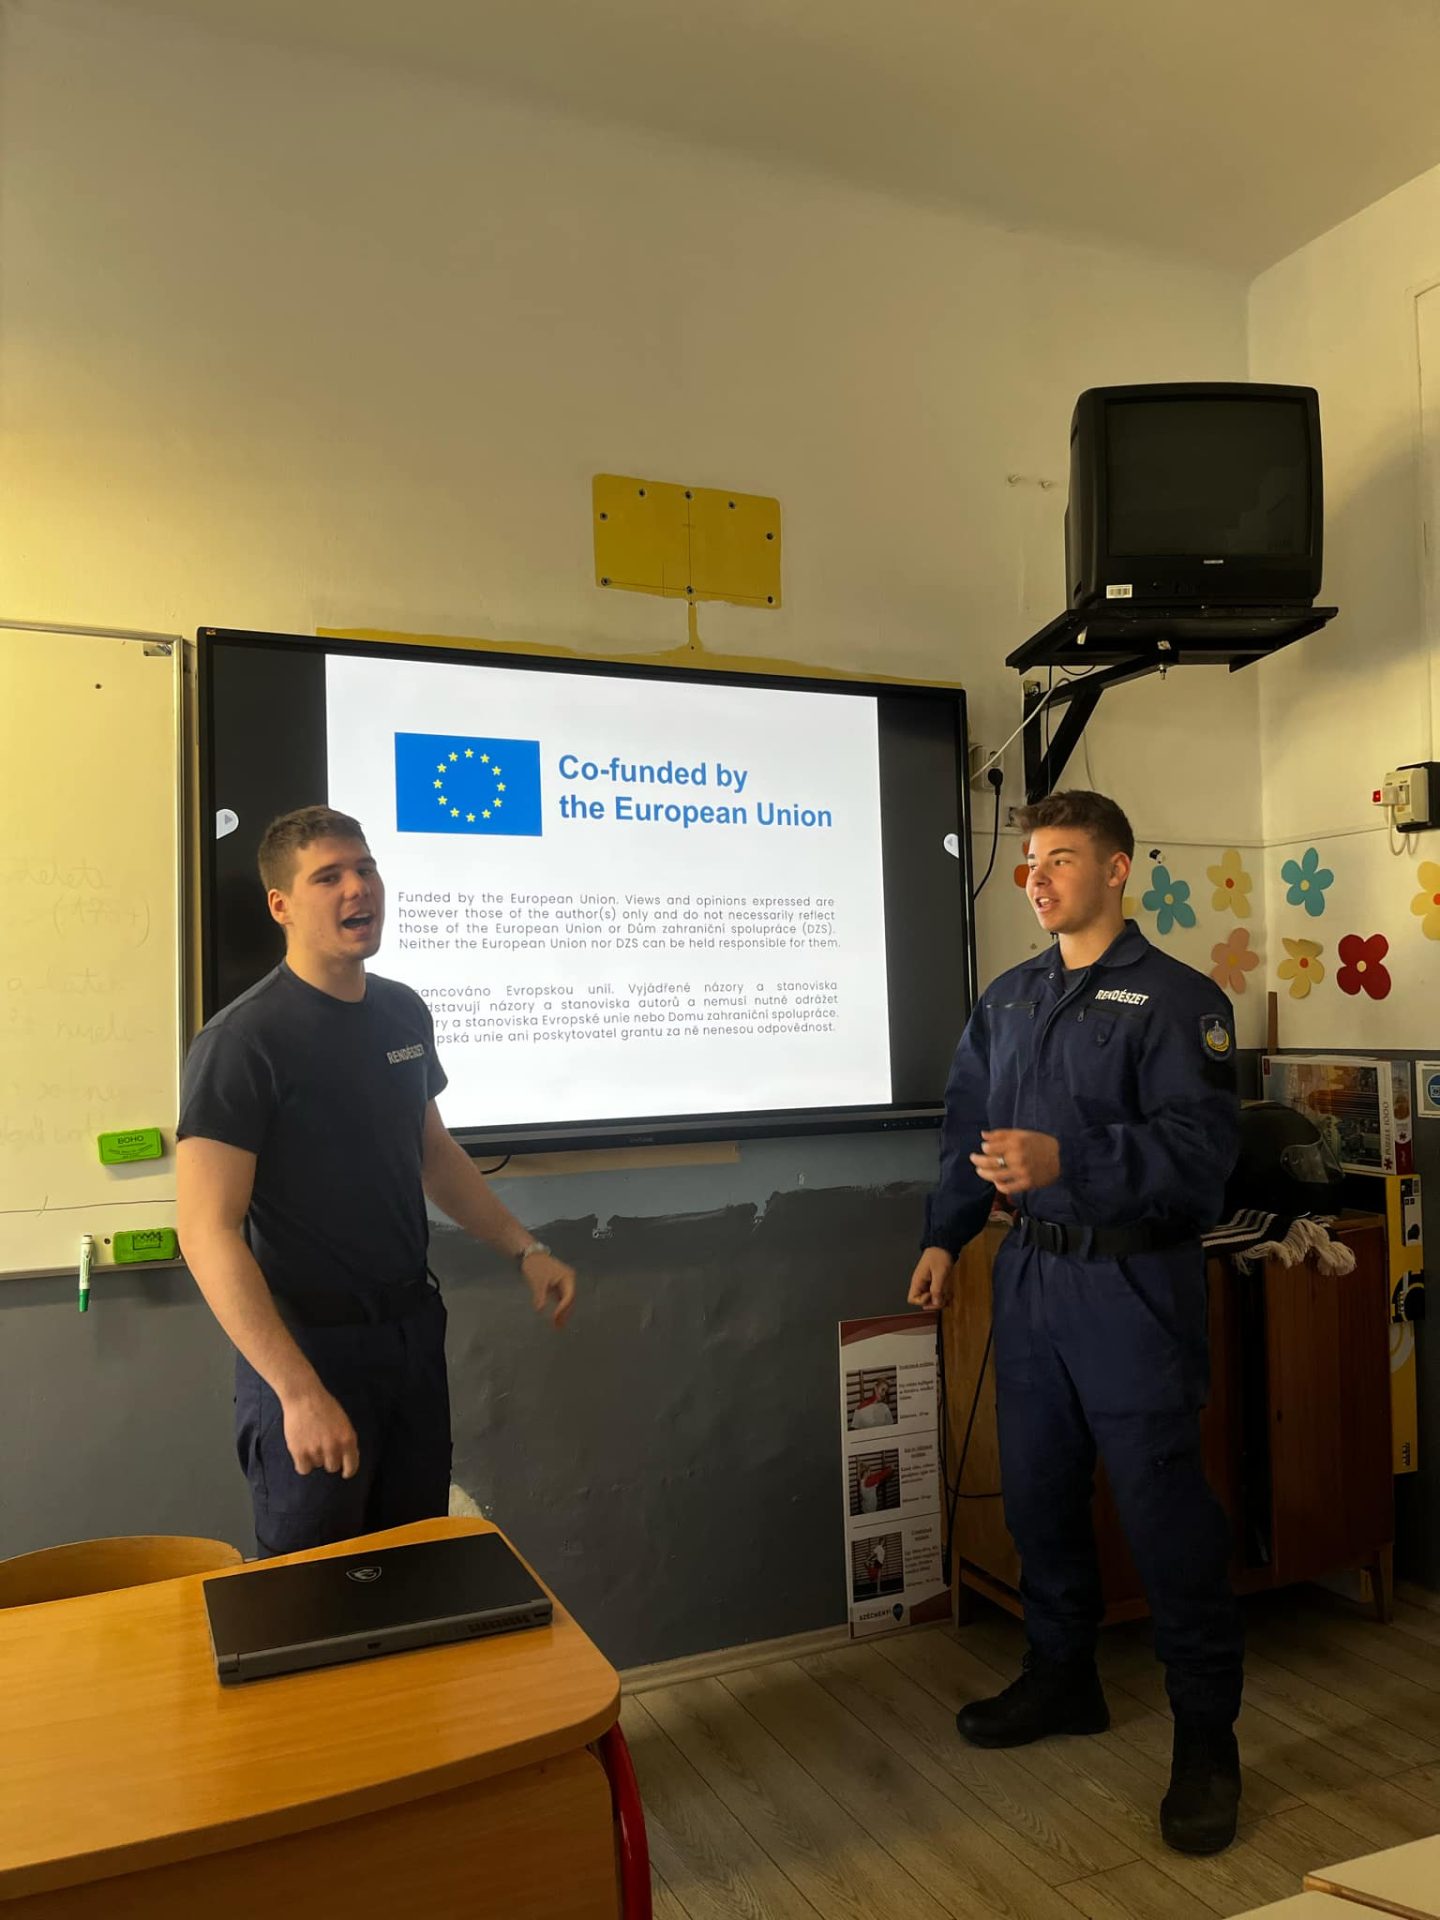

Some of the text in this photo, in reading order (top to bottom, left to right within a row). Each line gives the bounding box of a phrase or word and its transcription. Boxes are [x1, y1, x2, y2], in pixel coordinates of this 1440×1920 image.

[558, 754, 748, 793] Co-funded by
[559, 794, 832, 829] the European Union
[398, 892, 835, 910] Funded by the European Union. Views and opinions expressed are
[399, 907, 835, 923] however those of the author(s) only and do not necessarily reflect
[399, 922, 836, 937] those of the European Union or Dům zahraniční spolupráce (DZS).
[400, 937, 840, 952] Neither the European Union nor DZS can be held responsible for them.
[417, 985, 491, 998] ancováno
[507, 984, 573, 999] Evropskou
[628, 981, 690, 997] Vyjádřené
[705, 980, 743, 996] názory
[756, 983, 764, 992] a
[777, 979, 837, 992] stanoviska
[1095, 989, 1149, 1005] RENDÉSZET
[428, 1000, 480, 1016] dstavují
[490, 999, 534, 1015] názory
[544, 1002, 552, 1011] a
[561, 997, 629, 1010] stanoviska
[638, 996, 679, 1009] autorů
[688, 999, 695, 1007] a
[704, 994, 748, 1007] nemusí
[795, 992, 839, 1005] odrážet
[452, 1018, 461, 1027] a
[466, 1014, 538, 1027] stanoviska
[542, 1012, 600, 1028] Evropské
[604, 1011, 630, 1023] unie
[634, 1010, 665, 1023] nebo
[669, 1009, 703, 1022] Domu
[707, 1007, 769, 1021] zahraniční
[771, 1005, 839, 1022] spolupráce.
[437, 1020, 835, 1046] pská unie ani poskytovatel grantu za ně nenesou odpovědnost.
[117, 1135, 145, 1145] BOHO
